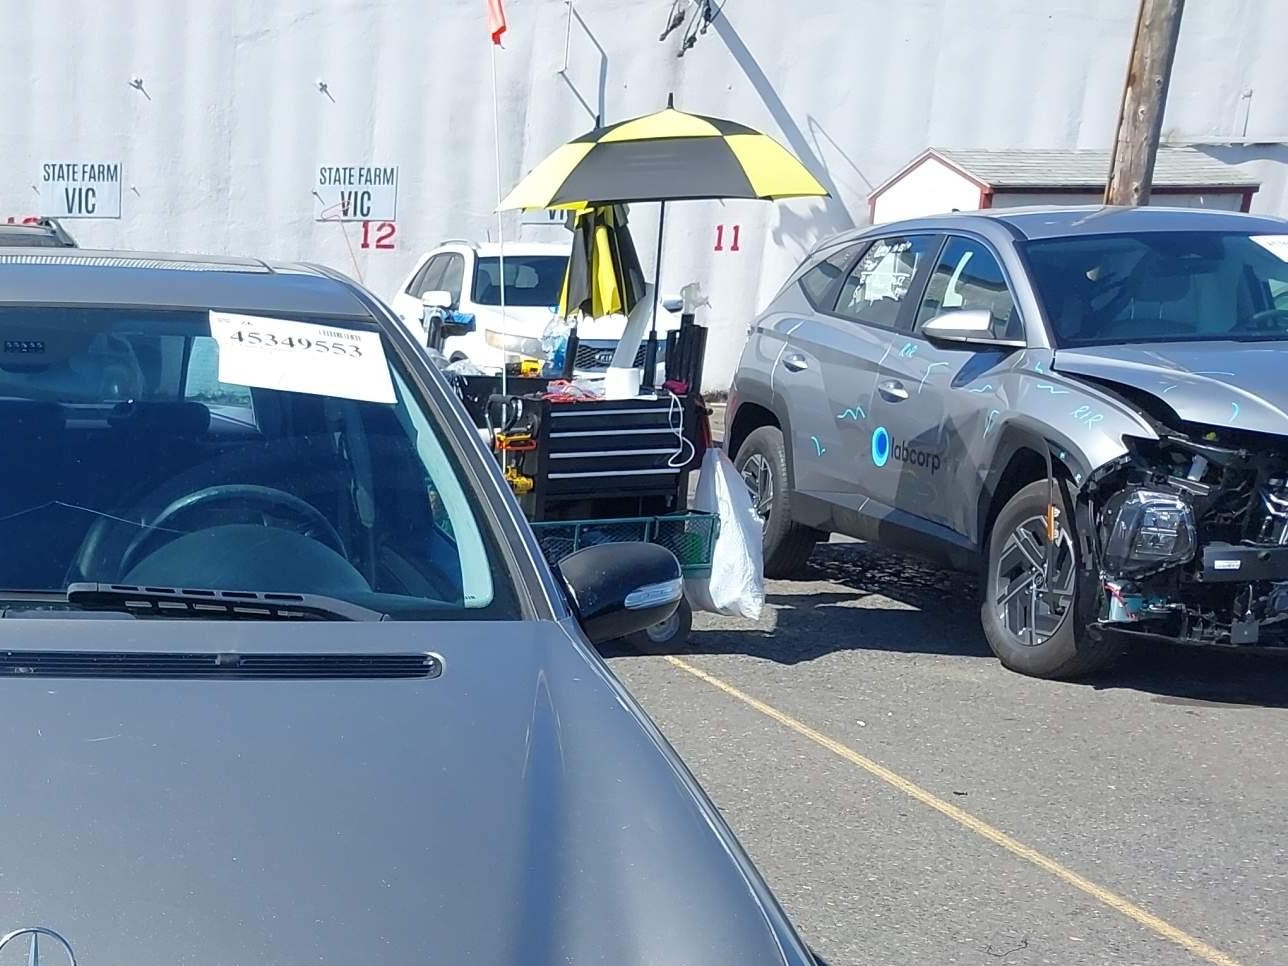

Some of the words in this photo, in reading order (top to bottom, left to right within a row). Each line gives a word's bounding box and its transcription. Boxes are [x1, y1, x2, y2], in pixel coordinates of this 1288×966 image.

[43, 163, 78, 182] STATE
[82, 164, 118, 182] FARM
[319, 167, 354, 185] STATE
[358, 167, 394, 185] FARM
[65, 187, 96, 214] VIC
[340, 190, 371, 217] VIC
[361, 221, 396, 249] 12
[714, 224, 739, 251] 11
[230, 330, 363, 358] 45349553
[891, 436, 941, 475] labcorp
